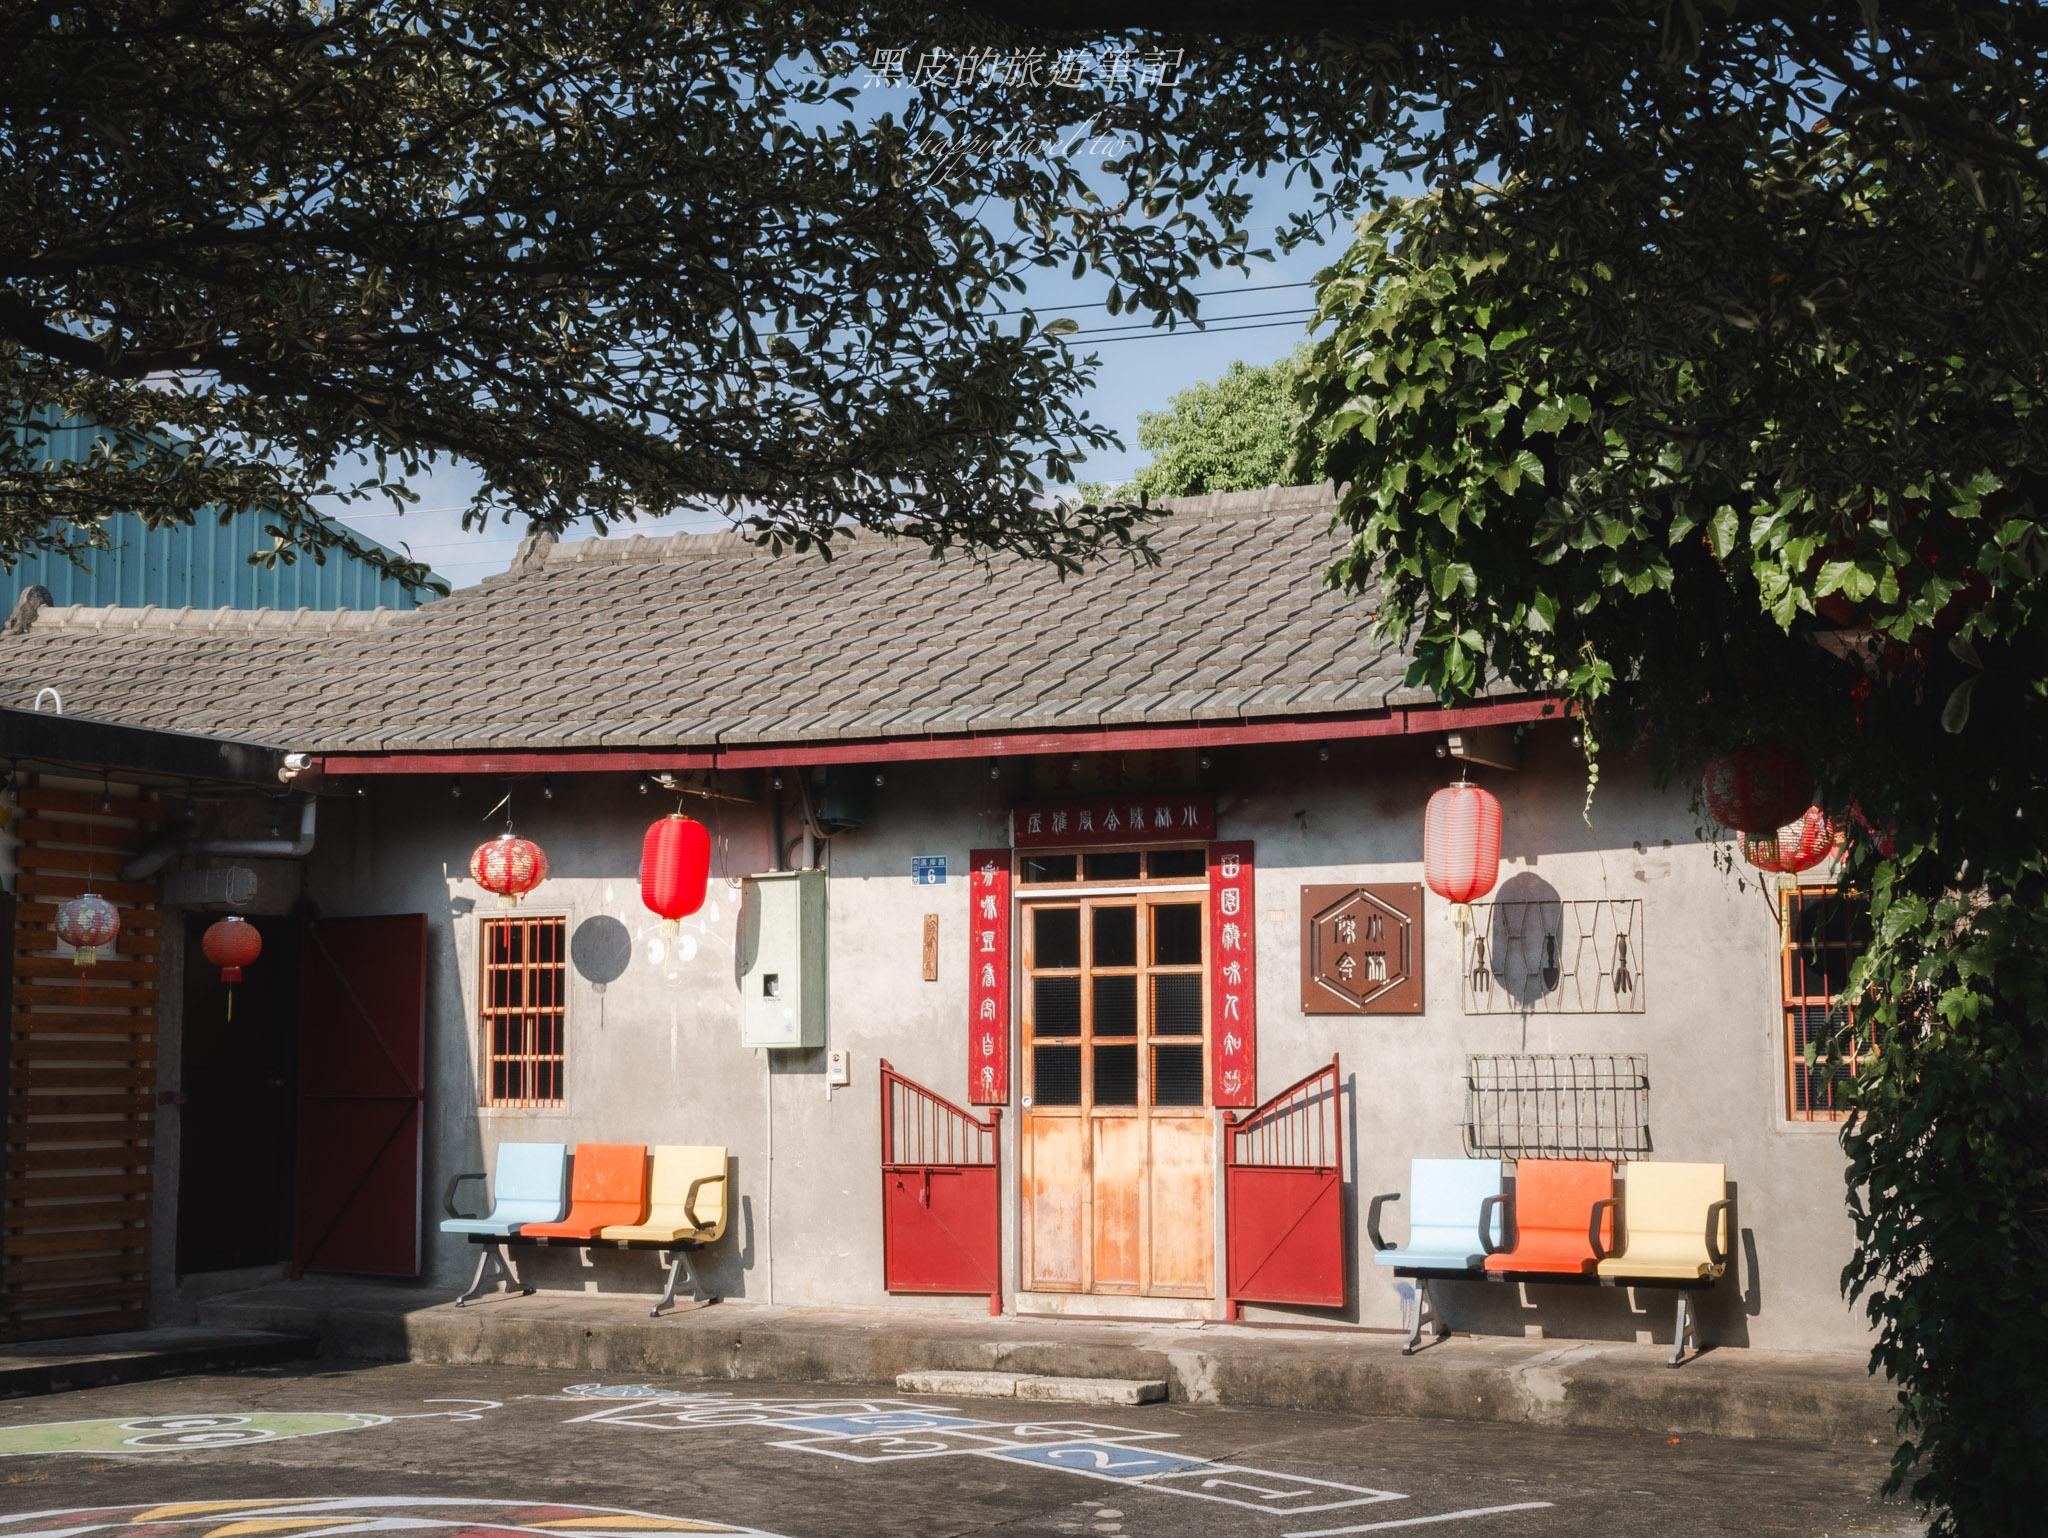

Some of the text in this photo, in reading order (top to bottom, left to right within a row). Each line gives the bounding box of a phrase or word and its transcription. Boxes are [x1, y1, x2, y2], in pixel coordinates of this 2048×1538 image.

[928, 868, 936, 884] 6
[676, 1411, 769, 1423] 6
[843, 1414, 939, 1429] 5
[1013, 1425, 1098, 1437] 4
[848, 1436, 949, 1453] 3
[1047, 1449, 1159, 1468] 2
[1201, 1478, 1313, 1499] 1
